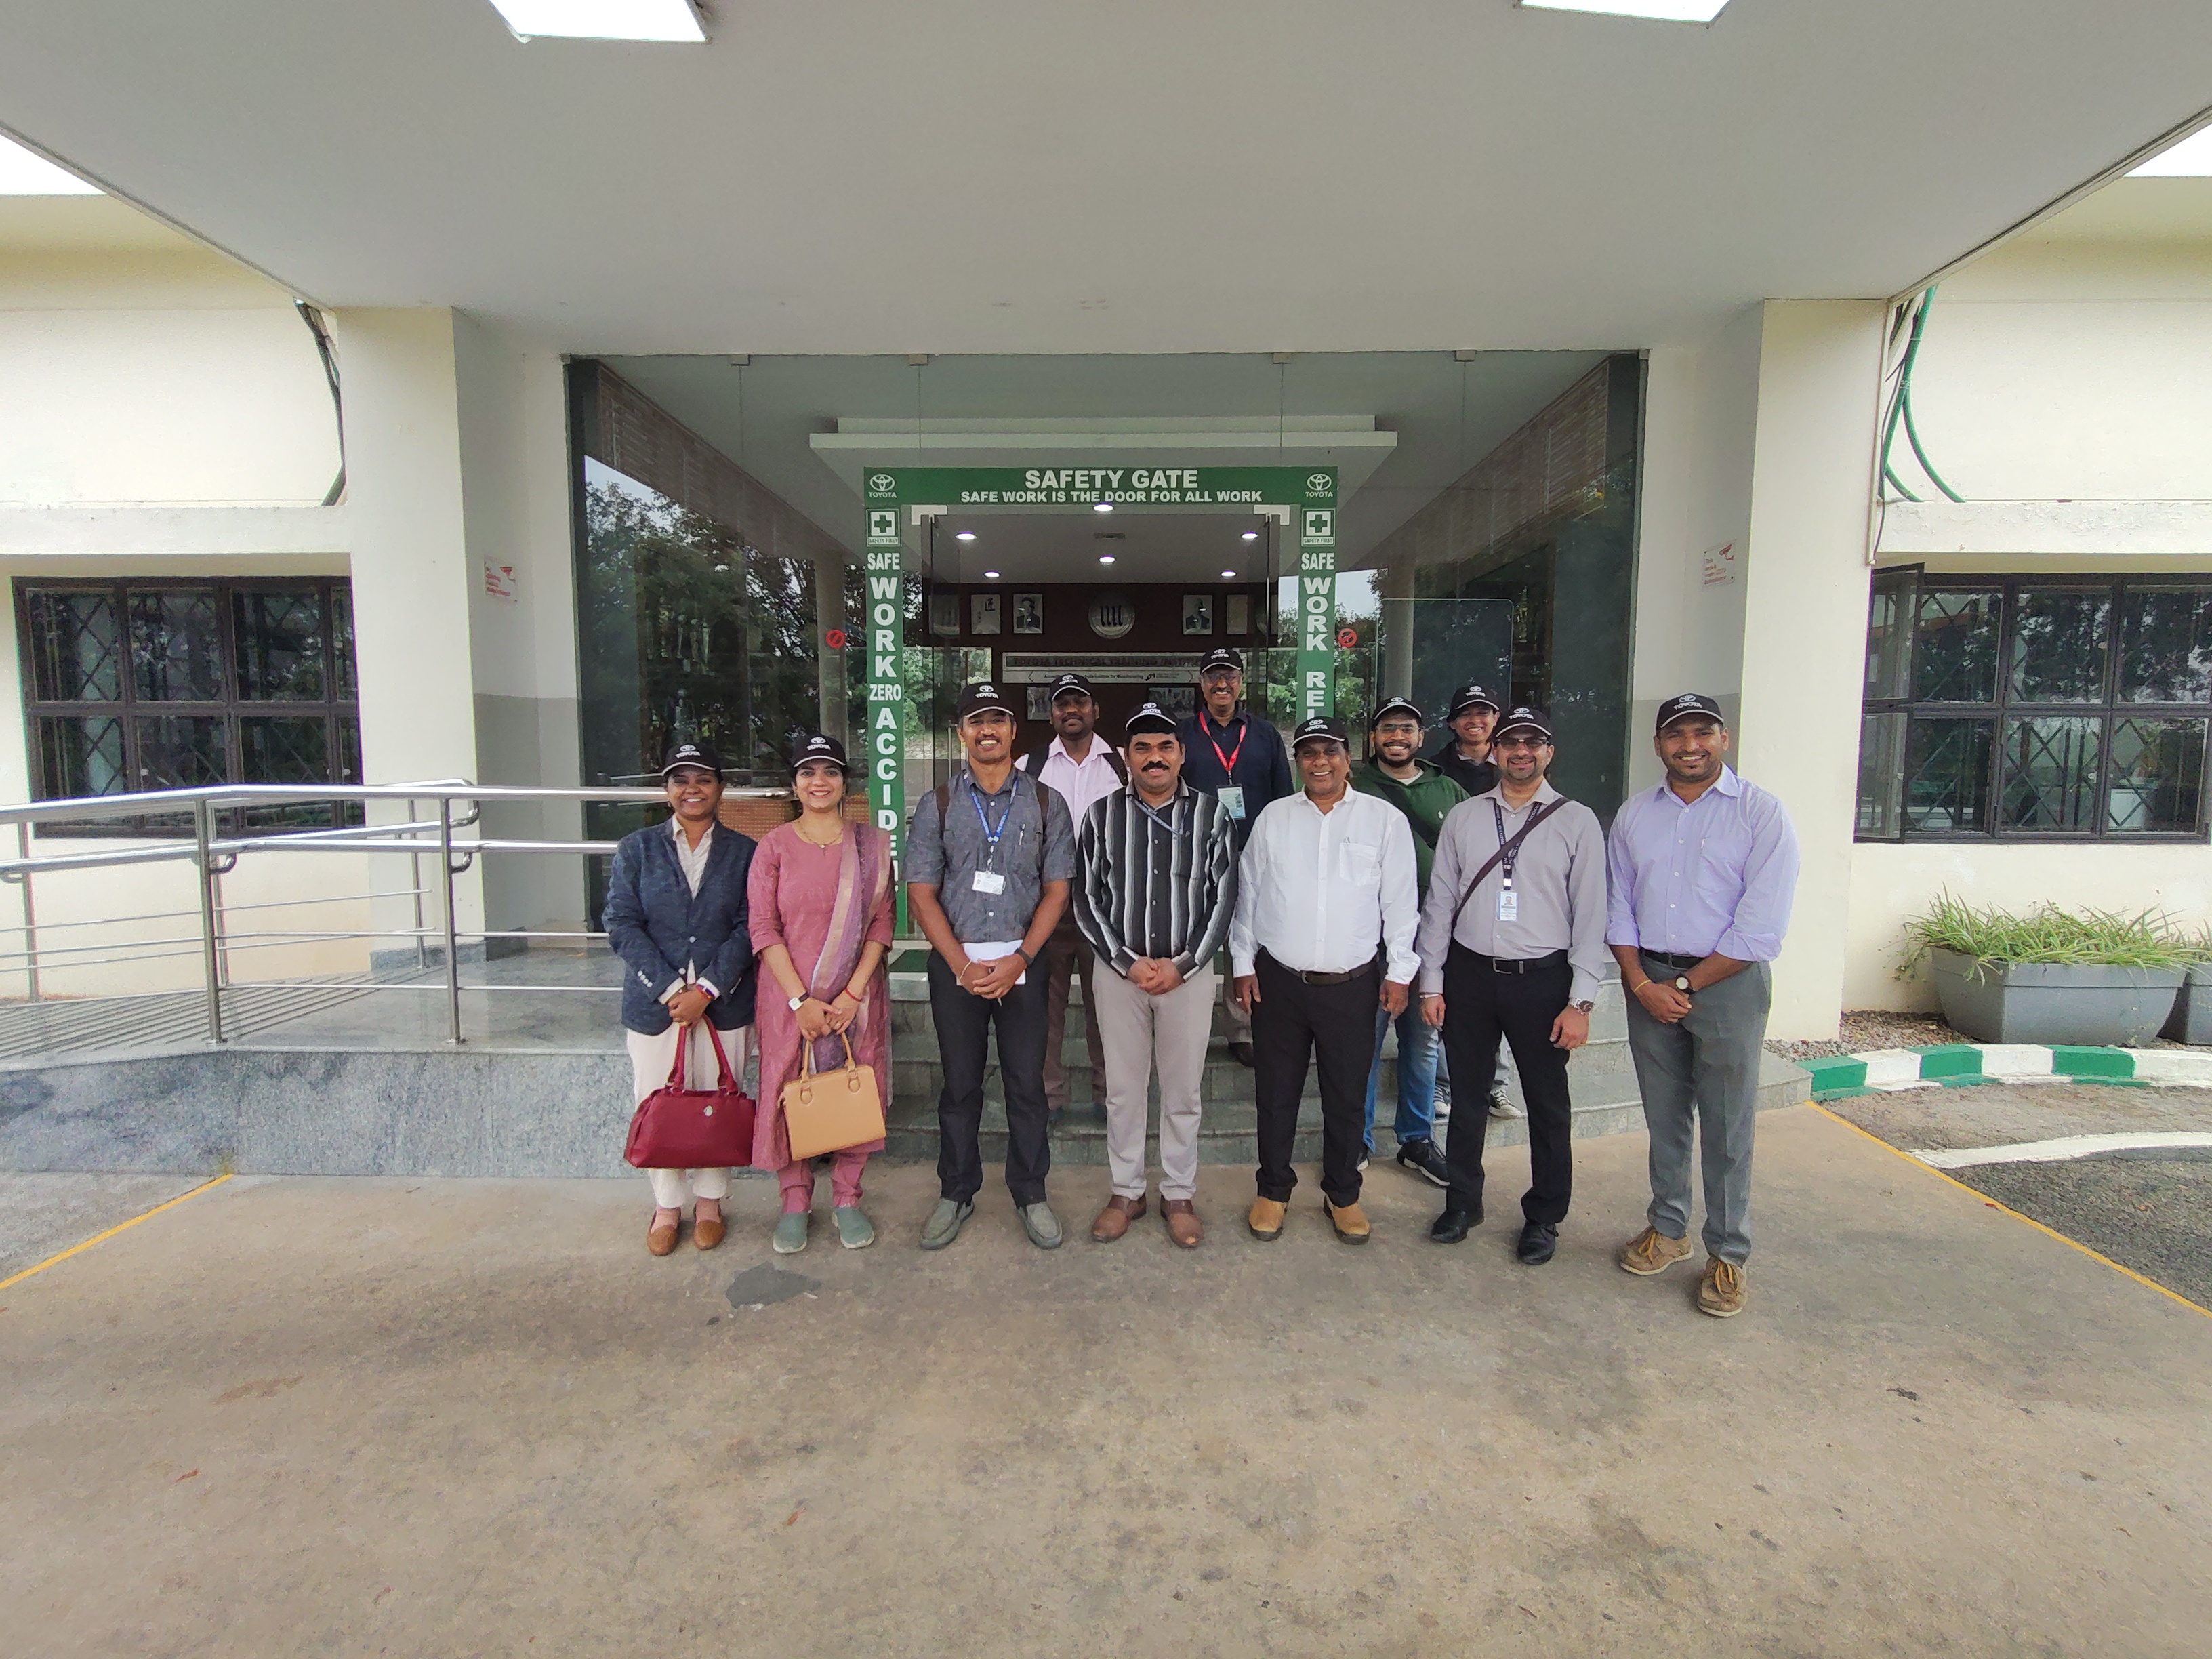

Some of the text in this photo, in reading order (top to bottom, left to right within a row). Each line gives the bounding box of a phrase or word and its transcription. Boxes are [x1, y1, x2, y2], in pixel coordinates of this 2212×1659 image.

[1025, 470, 1198, 489] SAFETY GATE
[961, 491, 1263, 503] SAFE WORK IS THE DOOR FOR ALL WORK
[867, 552, 901, 570] SAFE
[1300, 552, 1335, 570] SAFE
[1303, 577, 1332, 651] WORK
[869, 577, 898, 678] WORK
[869, 684, 902, 701] ZERO
[1673, 701, 1702, 710] TOYOTA
